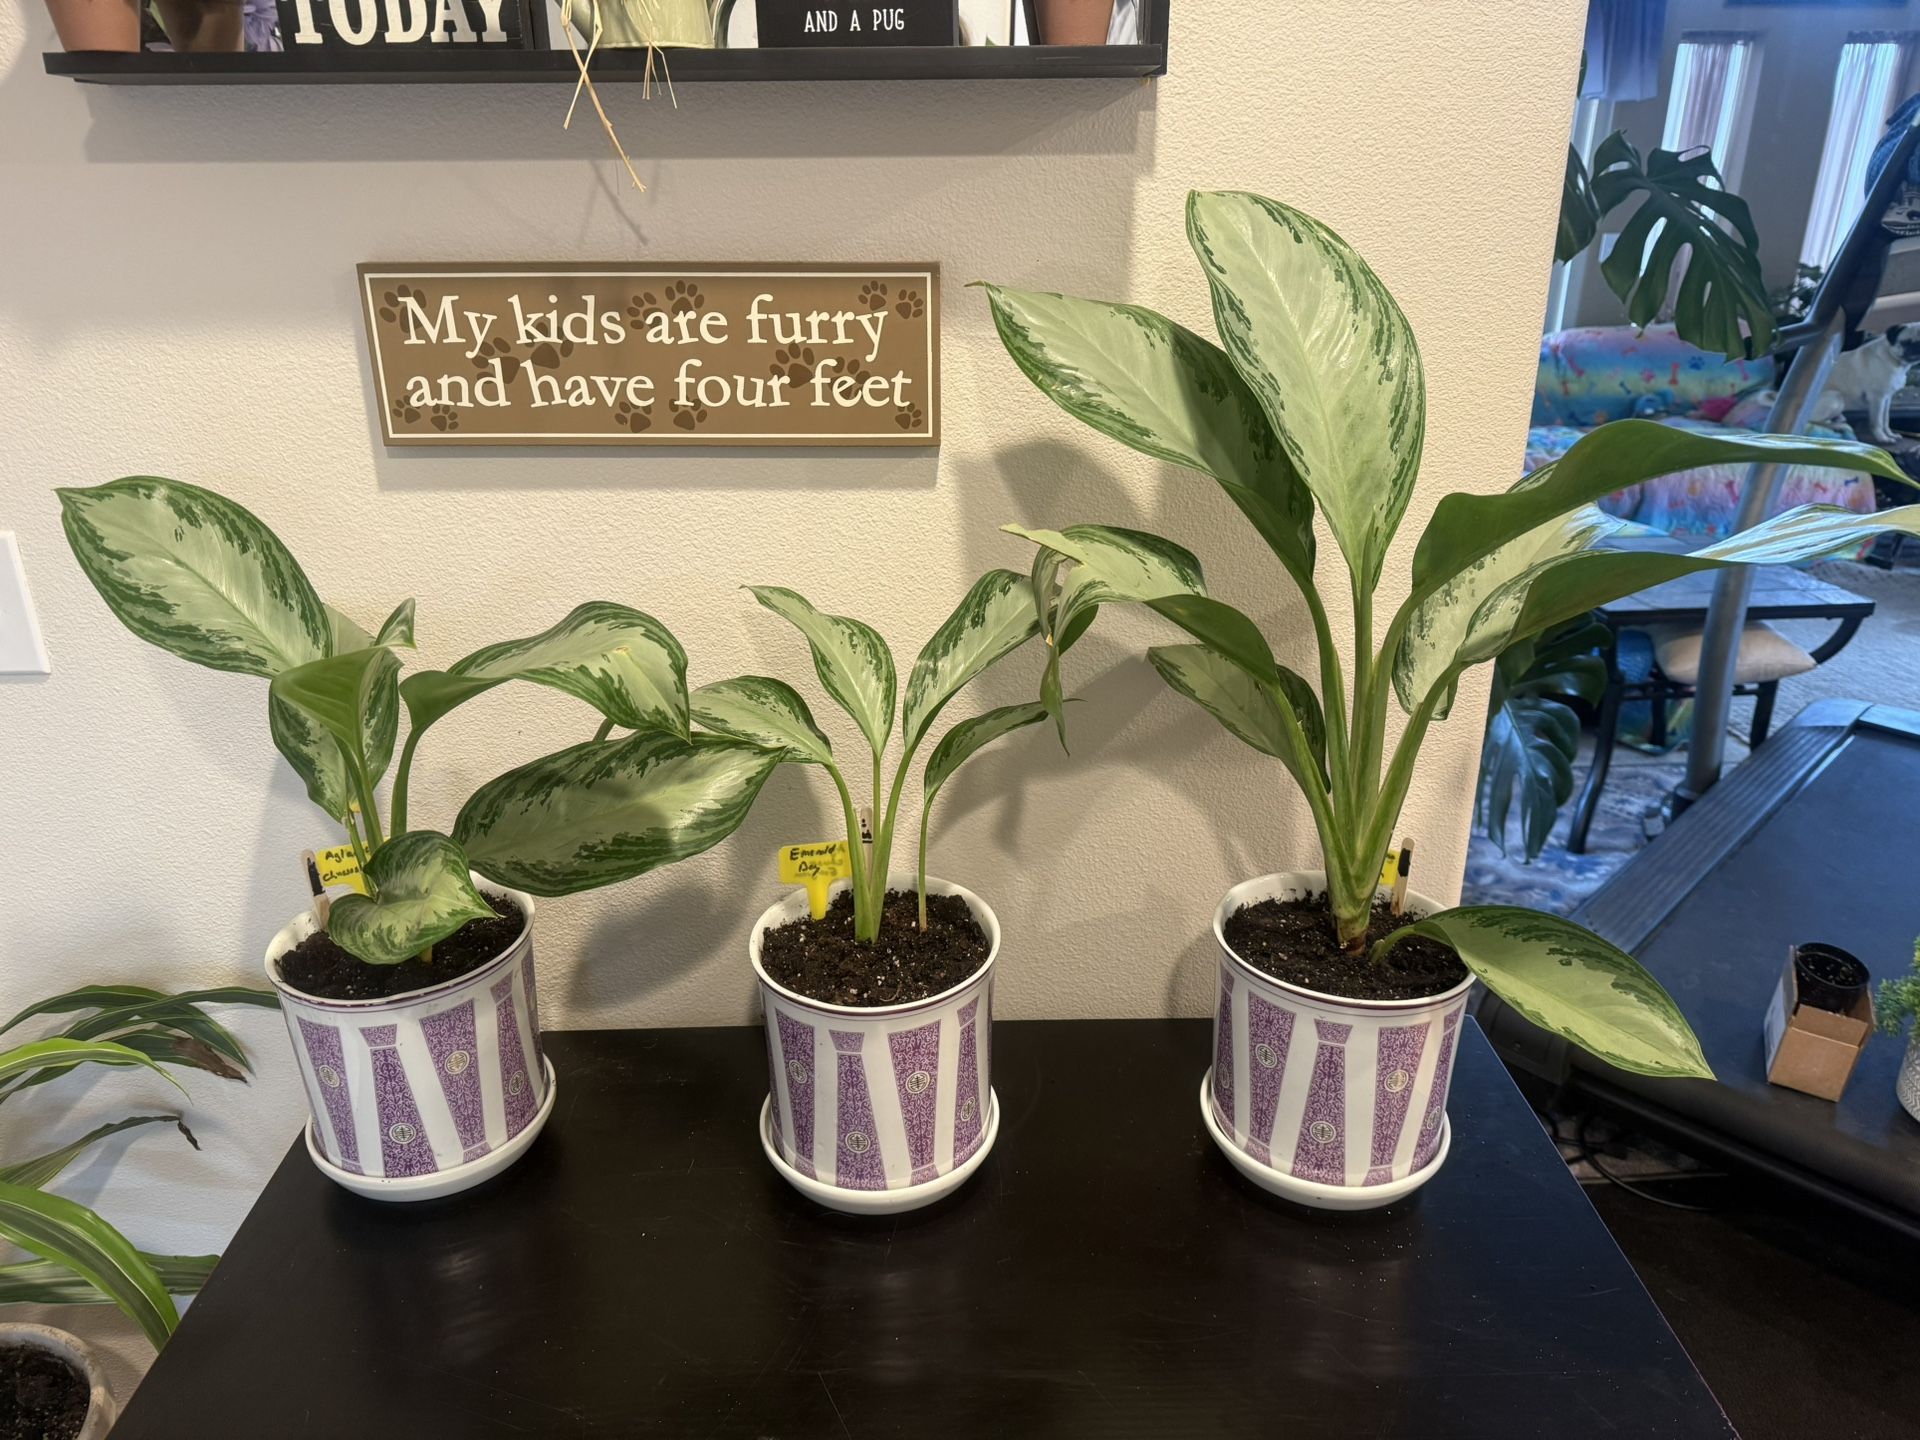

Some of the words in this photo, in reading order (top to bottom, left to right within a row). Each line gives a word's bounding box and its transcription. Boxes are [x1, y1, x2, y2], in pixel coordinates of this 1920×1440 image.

[294, 0, 508, 46] TODAY
[804, 10, 838, 32] AND
[849, 10, 861, 31] A
[872, 8, 905, 31] PUG
[397, 294, 498, 359] My
[507, 293, 626, 345] kids
[644, 309, 729, 345] are
[745, 293, 889, 362] furry
[405, 357, 512, 408] and
[519, 358, 655, 408] have
[673, 358, 791, 408] four
[809, 358, 912, 408] feet
